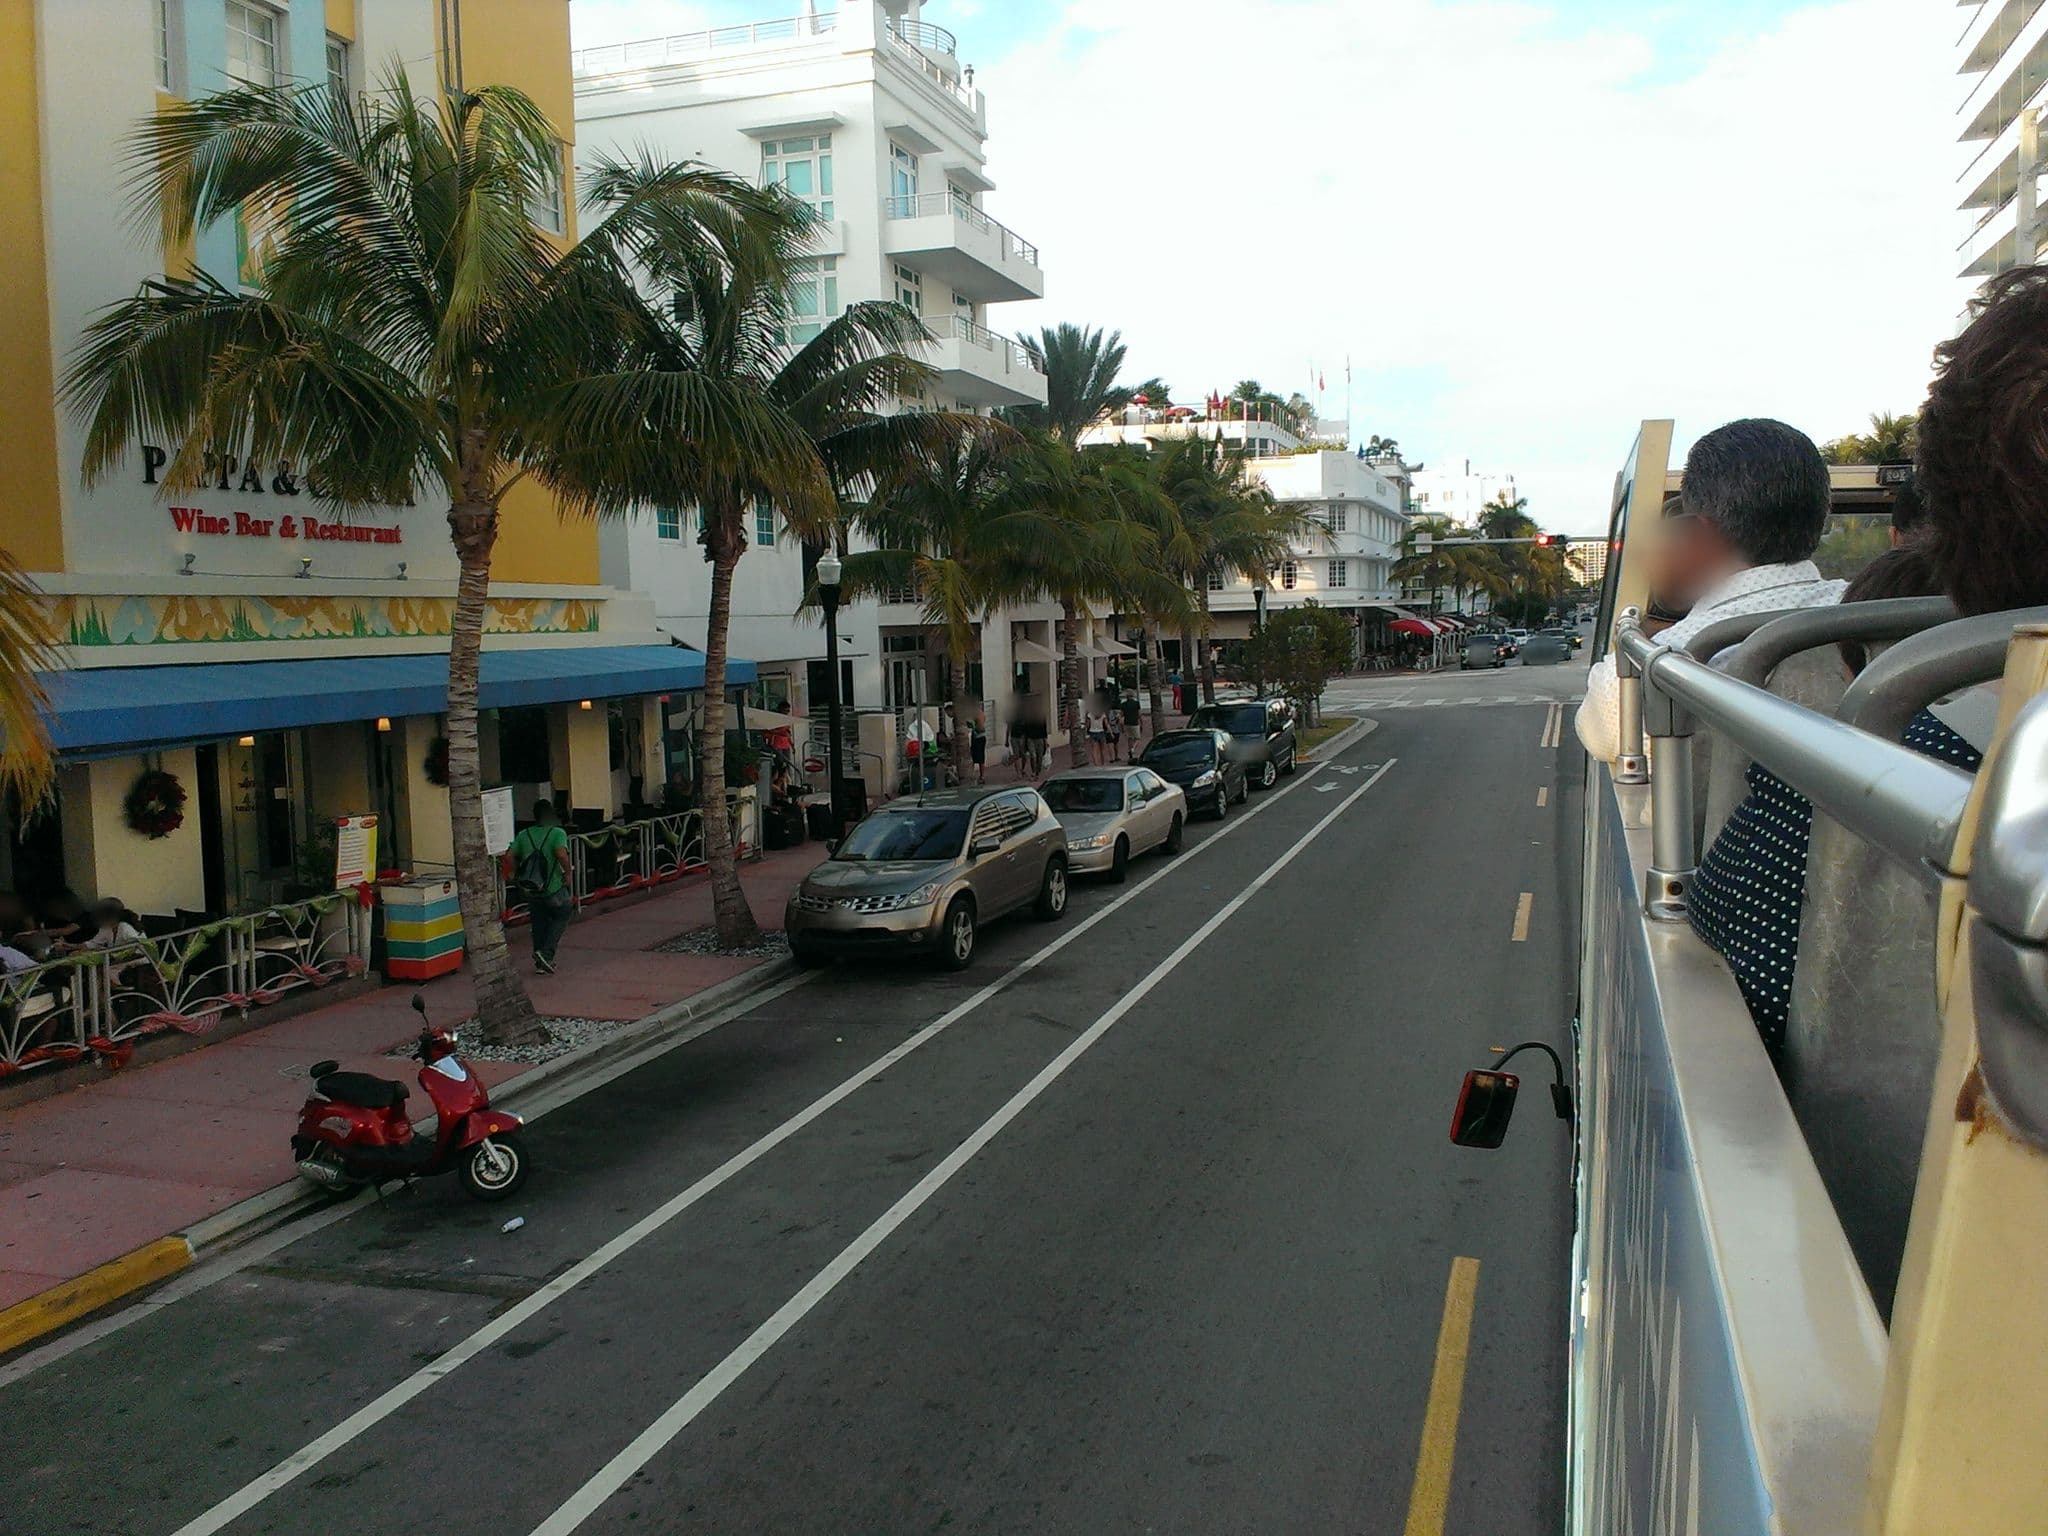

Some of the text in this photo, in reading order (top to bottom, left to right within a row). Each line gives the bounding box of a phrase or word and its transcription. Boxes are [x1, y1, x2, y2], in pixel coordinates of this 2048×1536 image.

[142, 445, 265, 493] PPPA
[272, 459, 300, 496] &
[168, 507, 403, 545] Wine Bar & Restaurant
